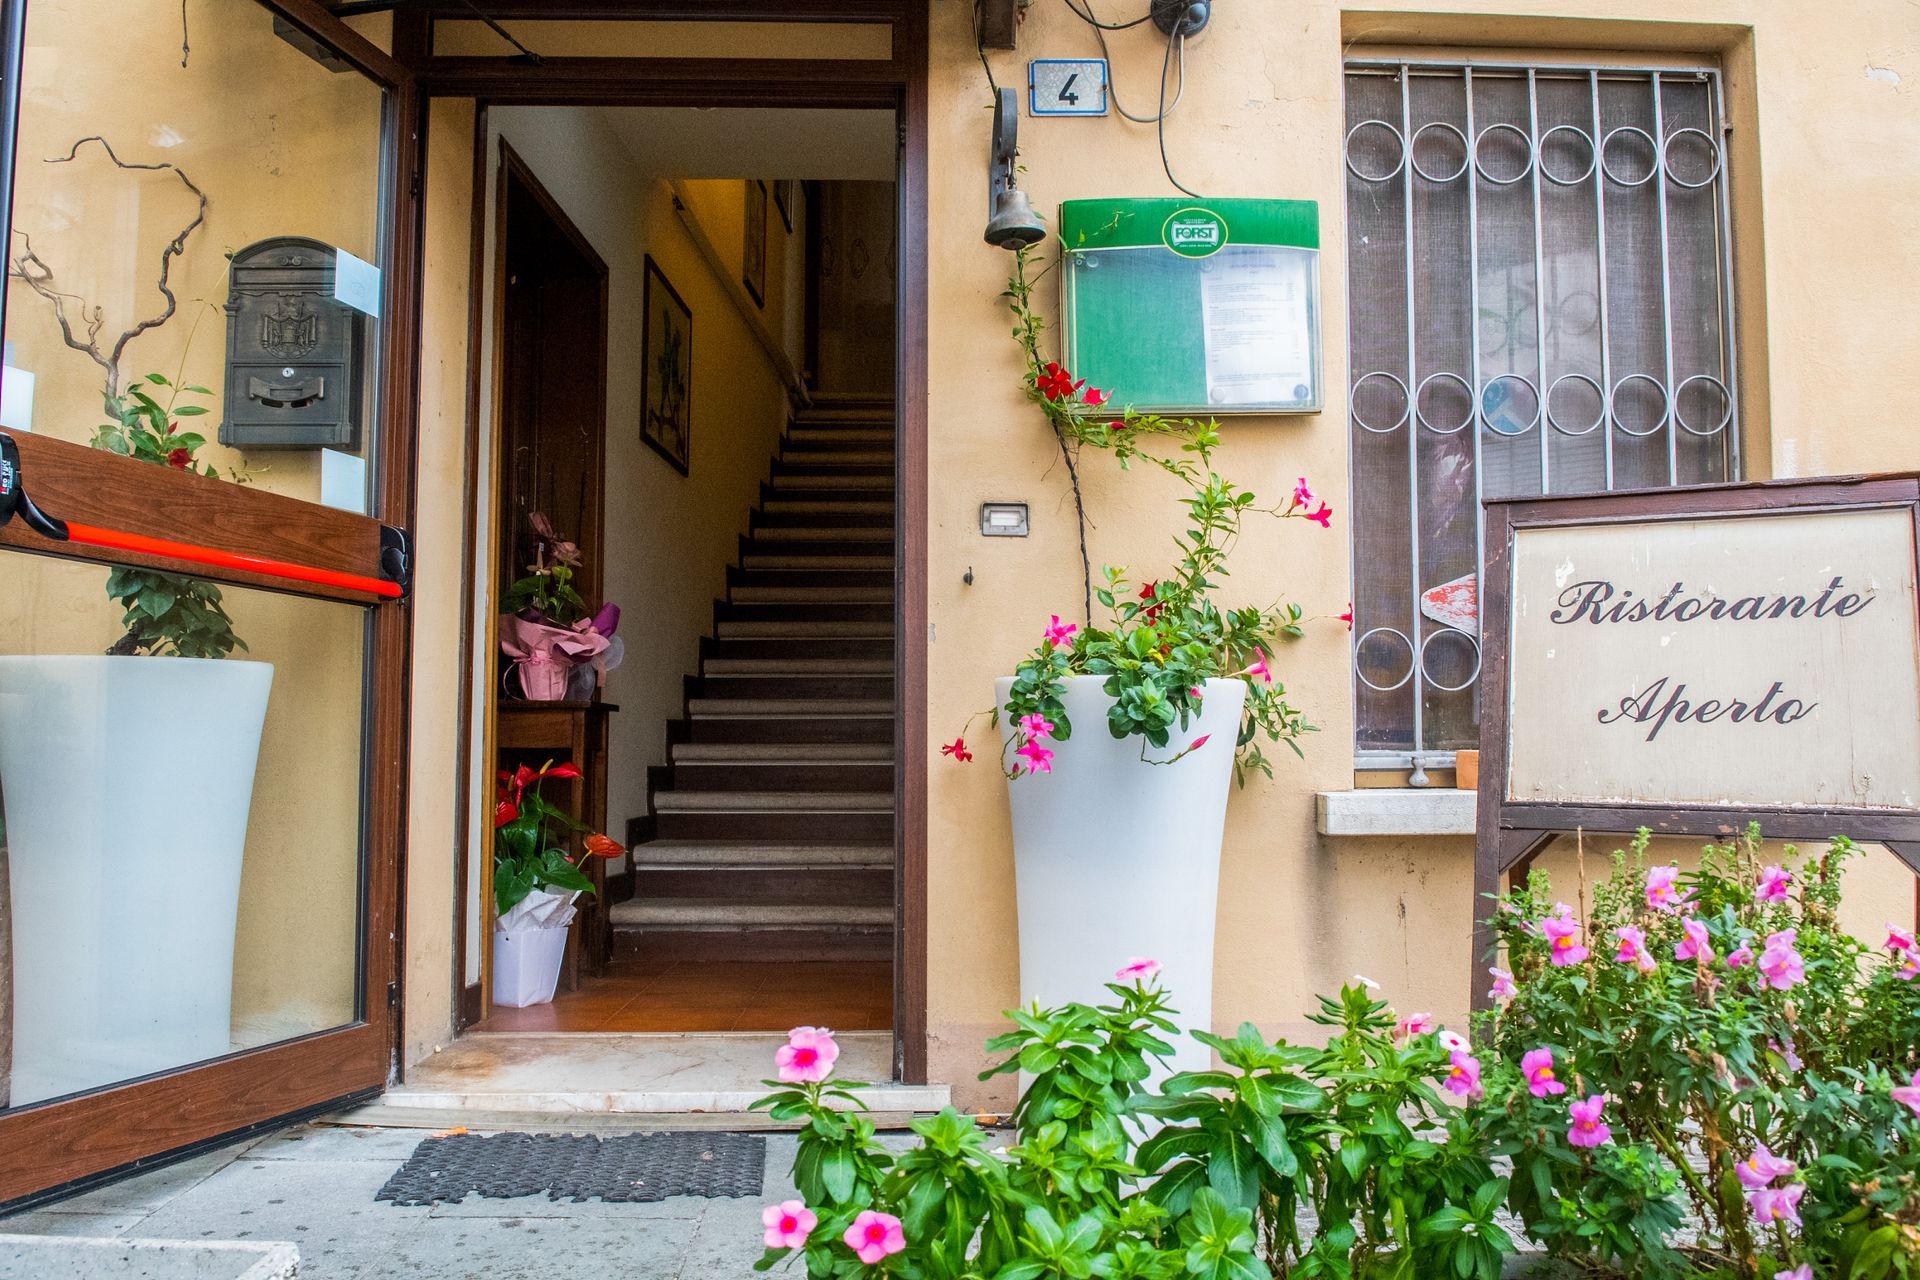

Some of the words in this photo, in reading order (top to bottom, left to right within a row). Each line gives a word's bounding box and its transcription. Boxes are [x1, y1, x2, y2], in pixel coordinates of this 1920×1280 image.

[1058, 73, 1079, 106] 4
[1175, 227, 1215, 239] FORST
[1550, 576, 1875, 625] Ristorante
[1597, 676, 1819, 742] Aperto
